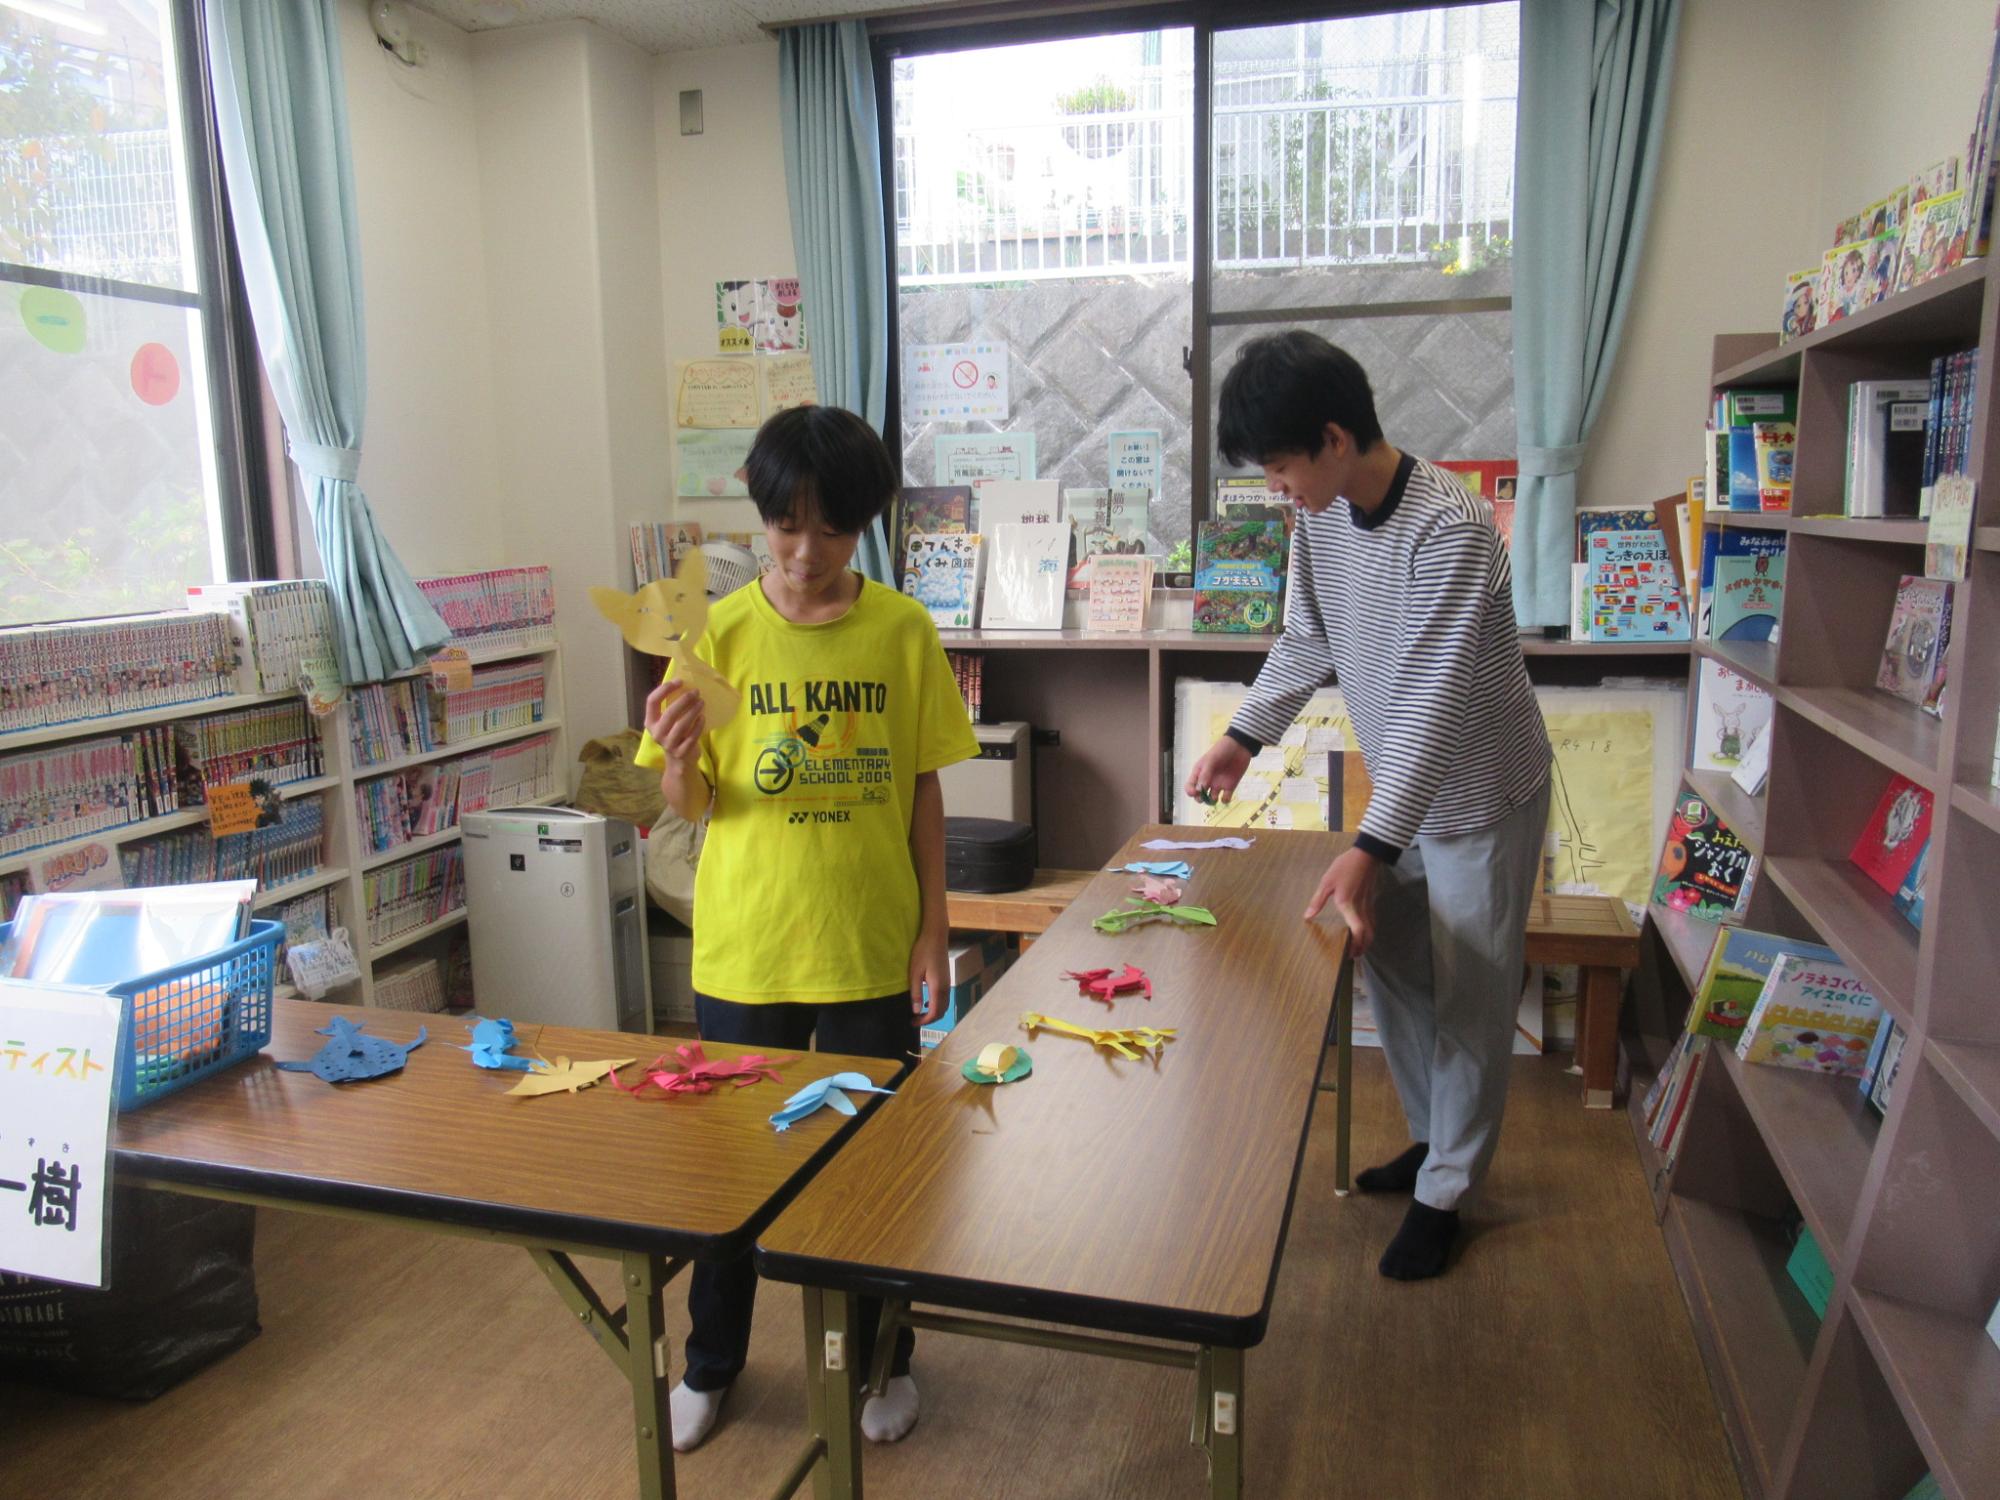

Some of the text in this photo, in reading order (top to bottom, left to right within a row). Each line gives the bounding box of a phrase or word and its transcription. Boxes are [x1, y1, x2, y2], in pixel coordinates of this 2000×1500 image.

[1116, 468, 1154, 478] 開けないで
[1021, 513, 1050, 524] 地球
[924, 536, 974, 554] てんきの
[1617, 541, 1660, 549] 世界がわかる
[1605, 549, 1671, 562] こっきのえほ
[913, 557, 975, 569] しくみ図鑑
[1039, 558, 1060, 574] 海
[751, 681, 887, 716] ALL KANTO
[805, 758, 891, 771] ELEMENTARY
[799, 771, 892, 785] SCHOOL 2009
[812, 811, 851, 823] YONEX
[1791, 971, 1873, 995] ノラネコぐん
[1800, 986, 1874, 1007] アイスのくに
[0, 1040, 104, 1081] ティスト
